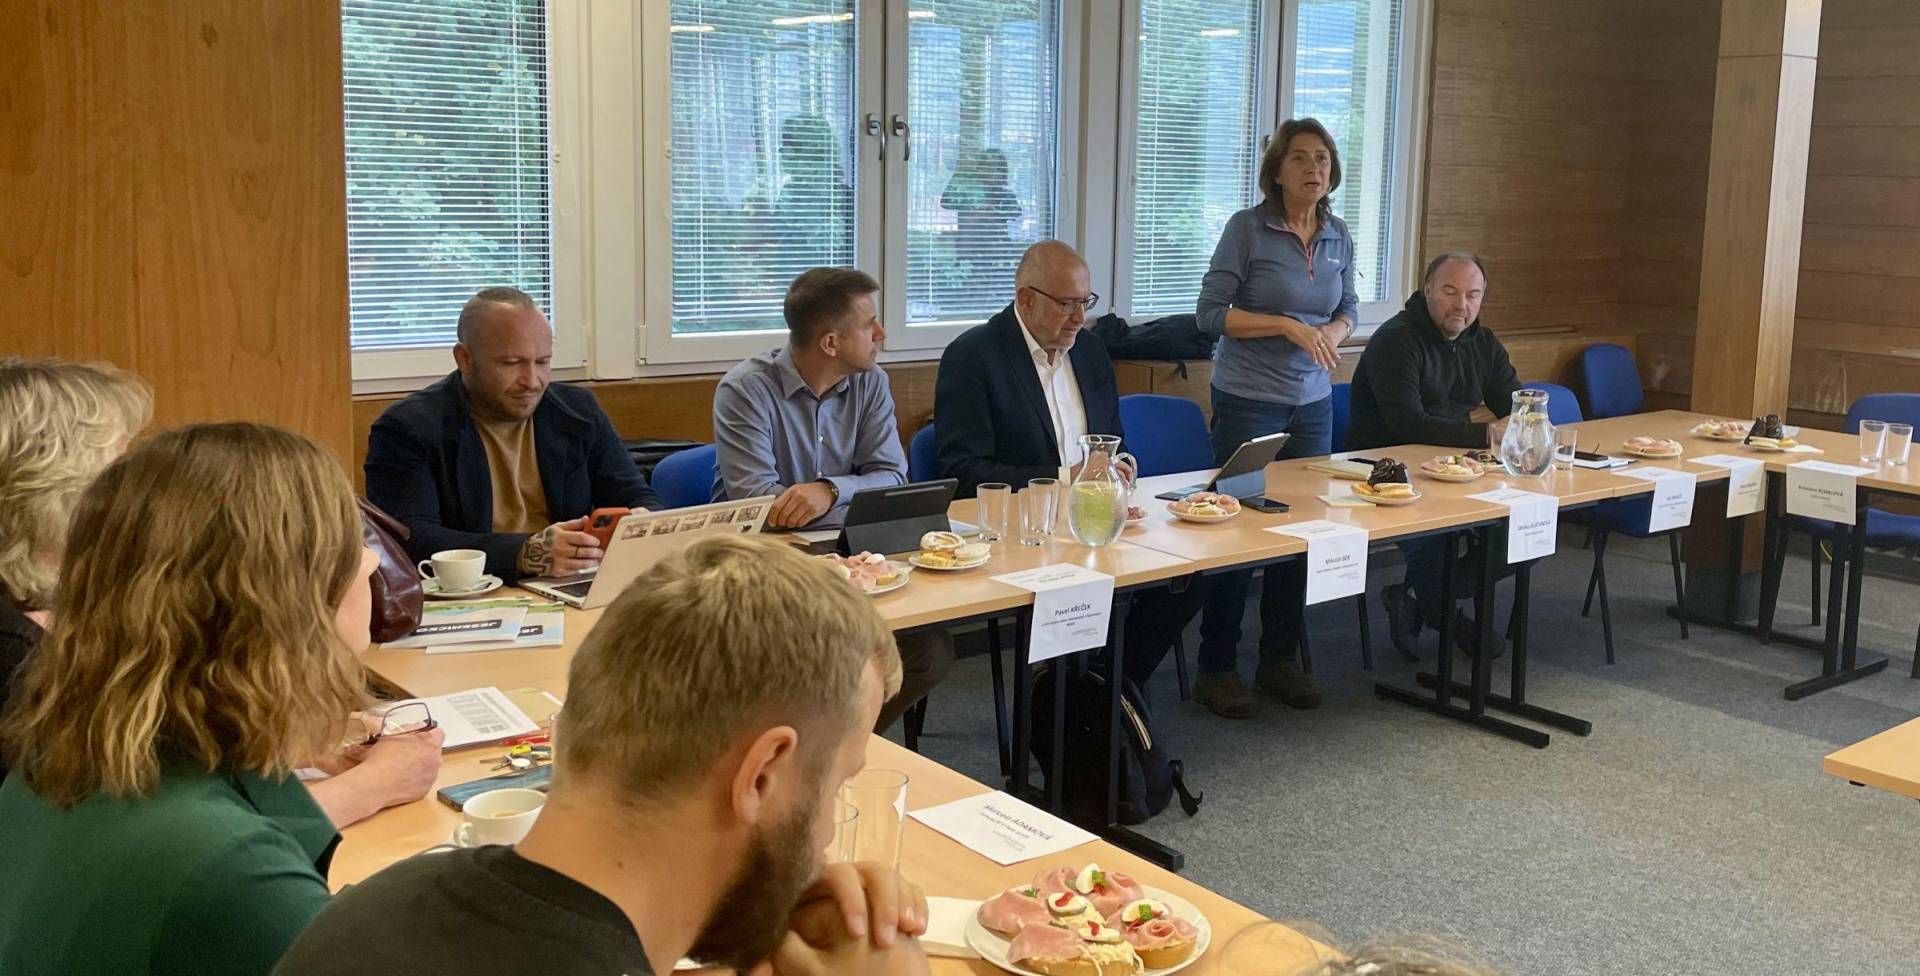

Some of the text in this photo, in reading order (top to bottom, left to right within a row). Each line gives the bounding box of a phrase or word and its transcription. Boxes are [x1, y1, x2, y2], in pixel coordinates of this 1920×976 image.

[1054, 608, 1070, 616] Pavel
[416, 621, 498, 633] JESENICKO
[1013, 818, 1053, 840] ADAMOVÁ
